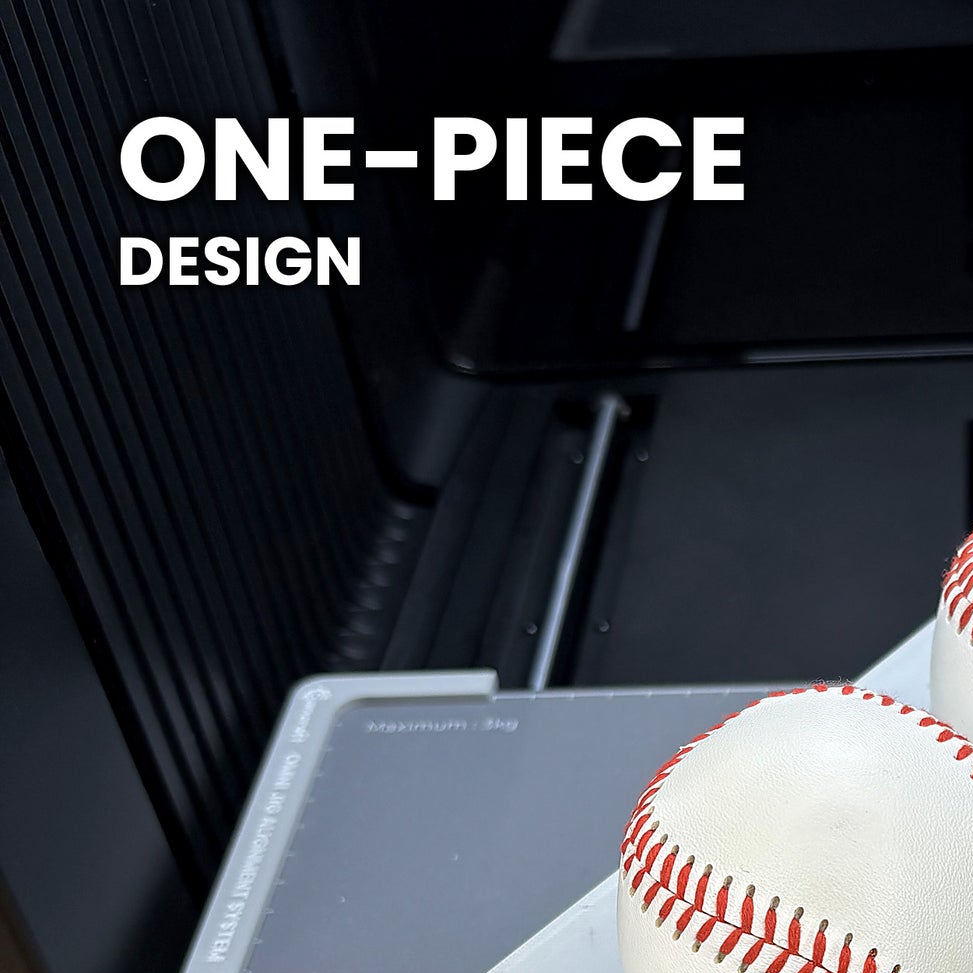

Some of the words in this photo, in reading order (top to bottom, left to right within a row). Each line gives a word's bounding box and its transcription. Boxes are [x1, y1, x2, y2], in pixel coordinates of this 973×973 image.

[274, 754, 302, 790] OMNI
[265, 792, 286, 814] JIG
[232, 816, 279, 900] ALIGNMENT
[207, 899, 246, 963] SYSTEM
